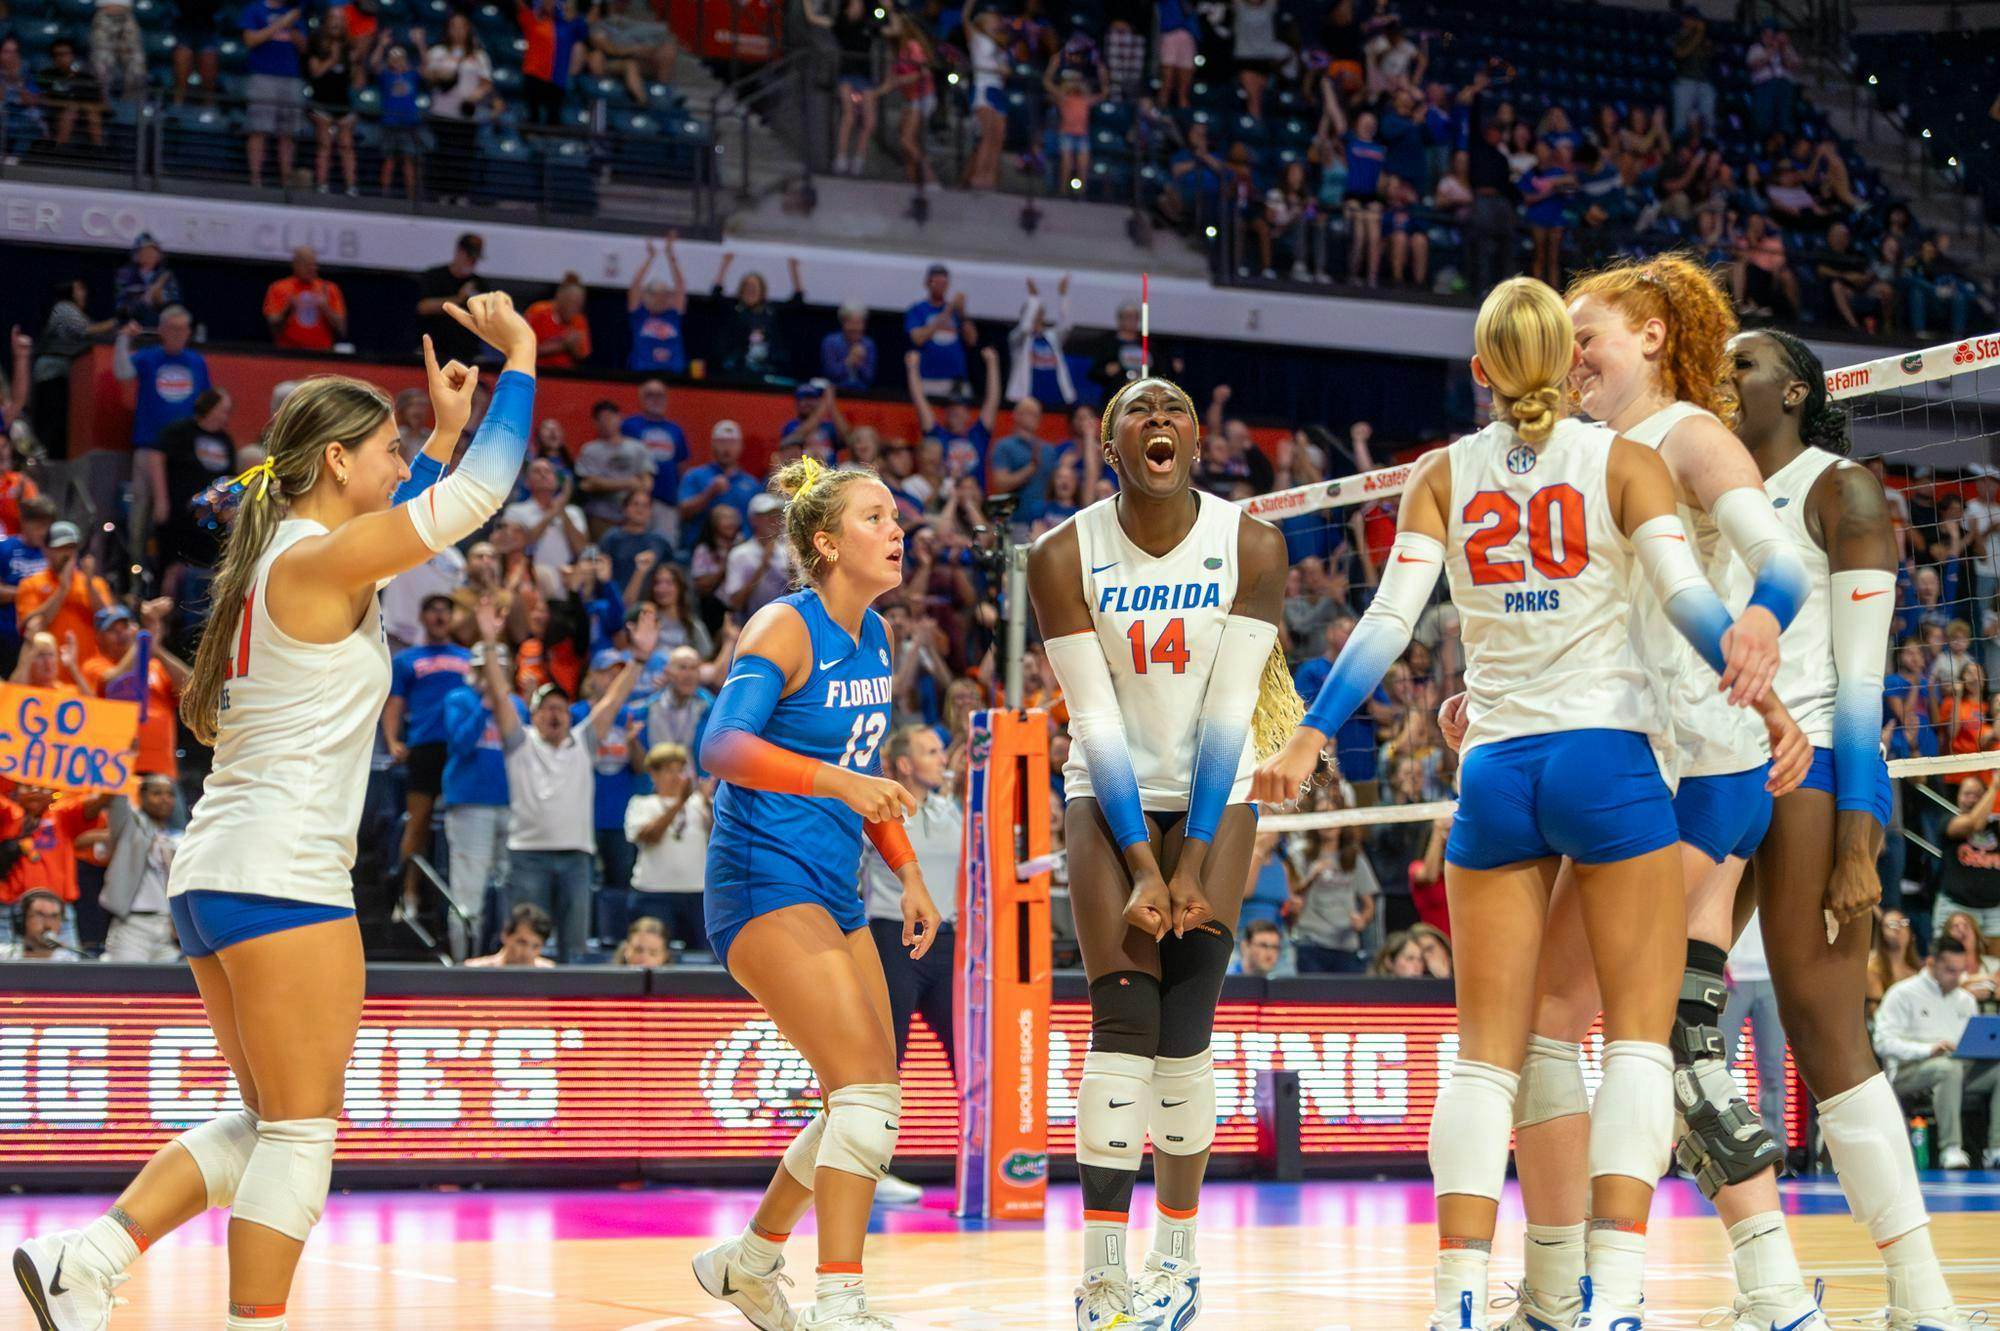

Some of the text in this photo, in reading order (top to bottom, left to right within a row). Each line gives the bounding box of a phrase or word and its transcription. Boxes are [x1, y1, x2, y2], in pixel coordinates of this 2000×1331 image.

[1463, 483, 1590, 586] 20
[1100, 583, 1219, 612] FLORIDA
[1505, 589, 1560, 612] PARKS
[1127, 618, 1190, 674] 14
[19, 697, 86, 736] GO
[839, 712, 887, 768] 13
[1018, 1009, 1034, 1134] sports imports
[1162, 1260, 1178, 1271] NIKE
